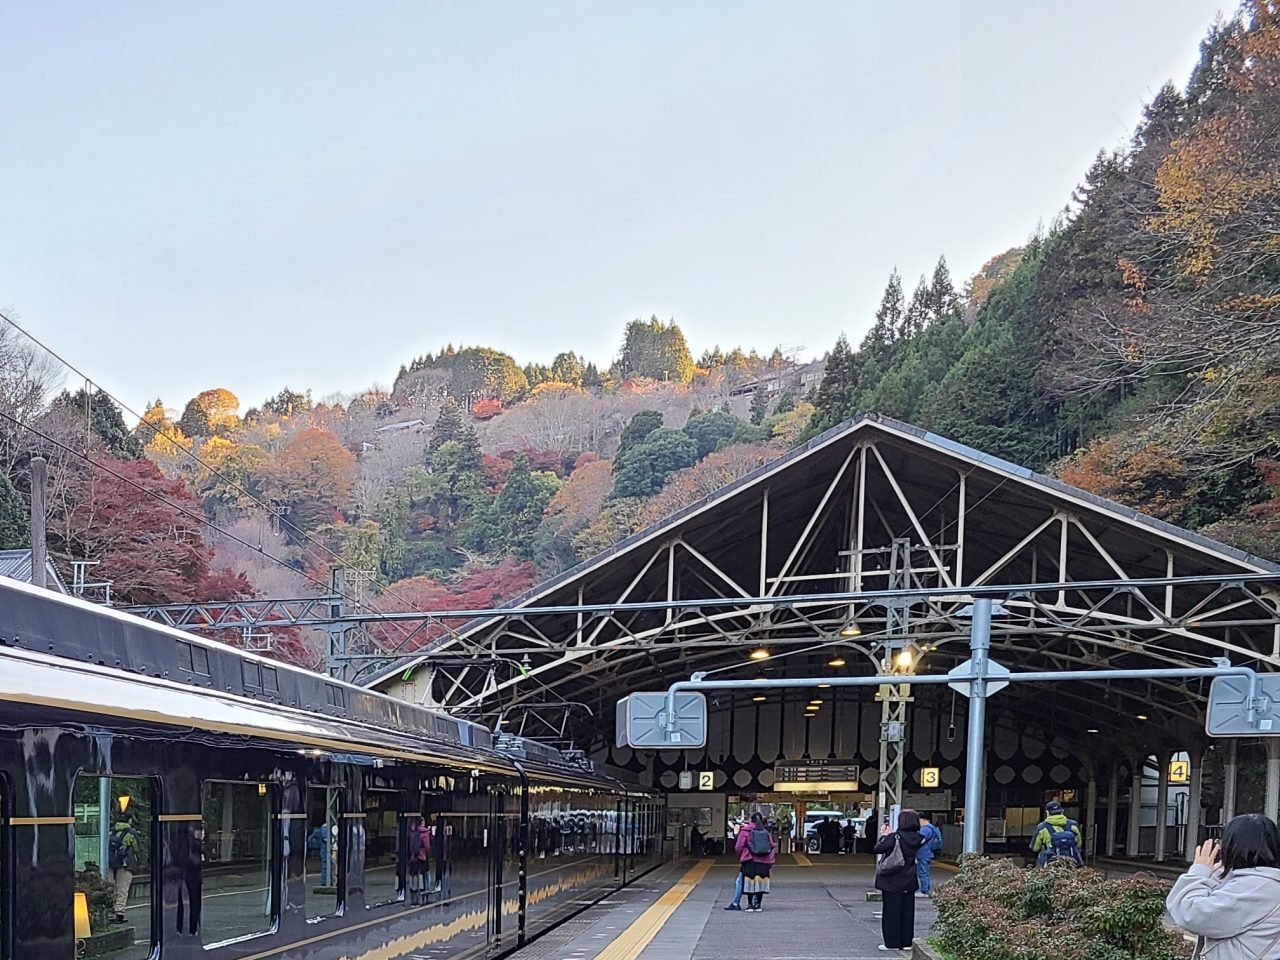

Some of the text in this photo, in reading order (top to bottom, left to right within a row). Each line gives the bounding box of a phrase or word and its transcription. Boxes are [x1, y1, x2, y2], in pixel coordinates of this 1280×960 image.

[925, 771, 936, 783] 3
[1172, 765, 1185, 778] 4
[701, 774, 711, 787] 2
